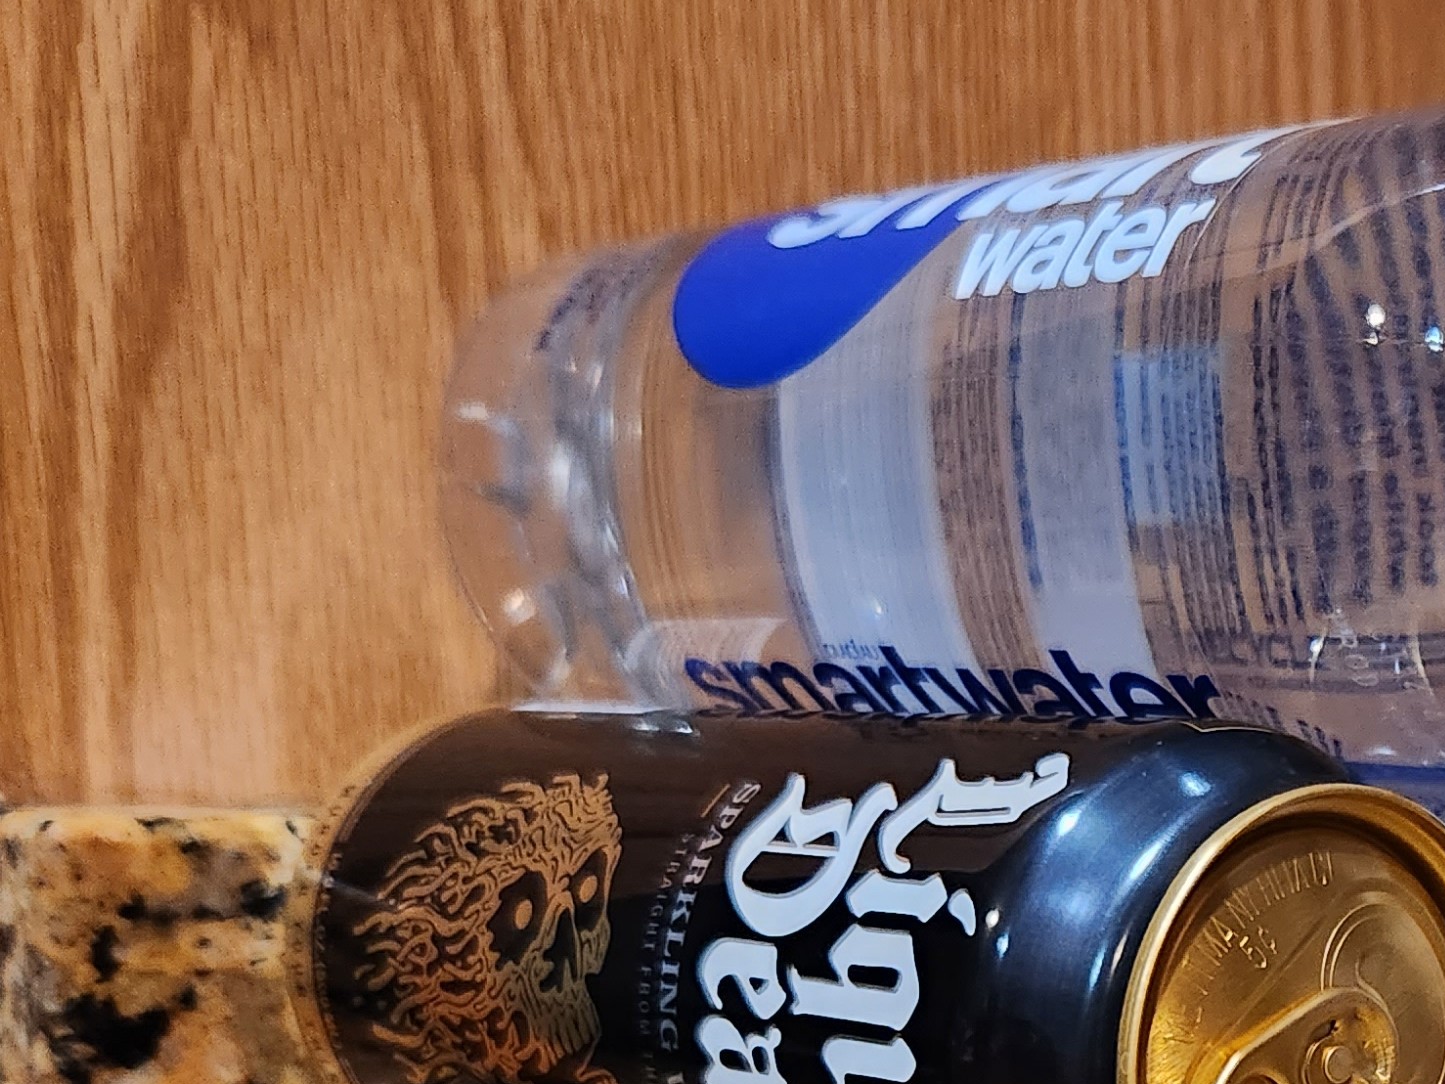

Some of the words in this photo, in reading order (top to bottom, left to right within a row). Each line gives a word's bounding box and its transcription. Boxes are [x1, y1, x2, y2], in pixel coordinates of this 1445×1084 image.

[954, 197, 1216, 300] water
[685, 643, 1223, 718] smartwater
[655, 780, 762, 1054] SPARKLING
